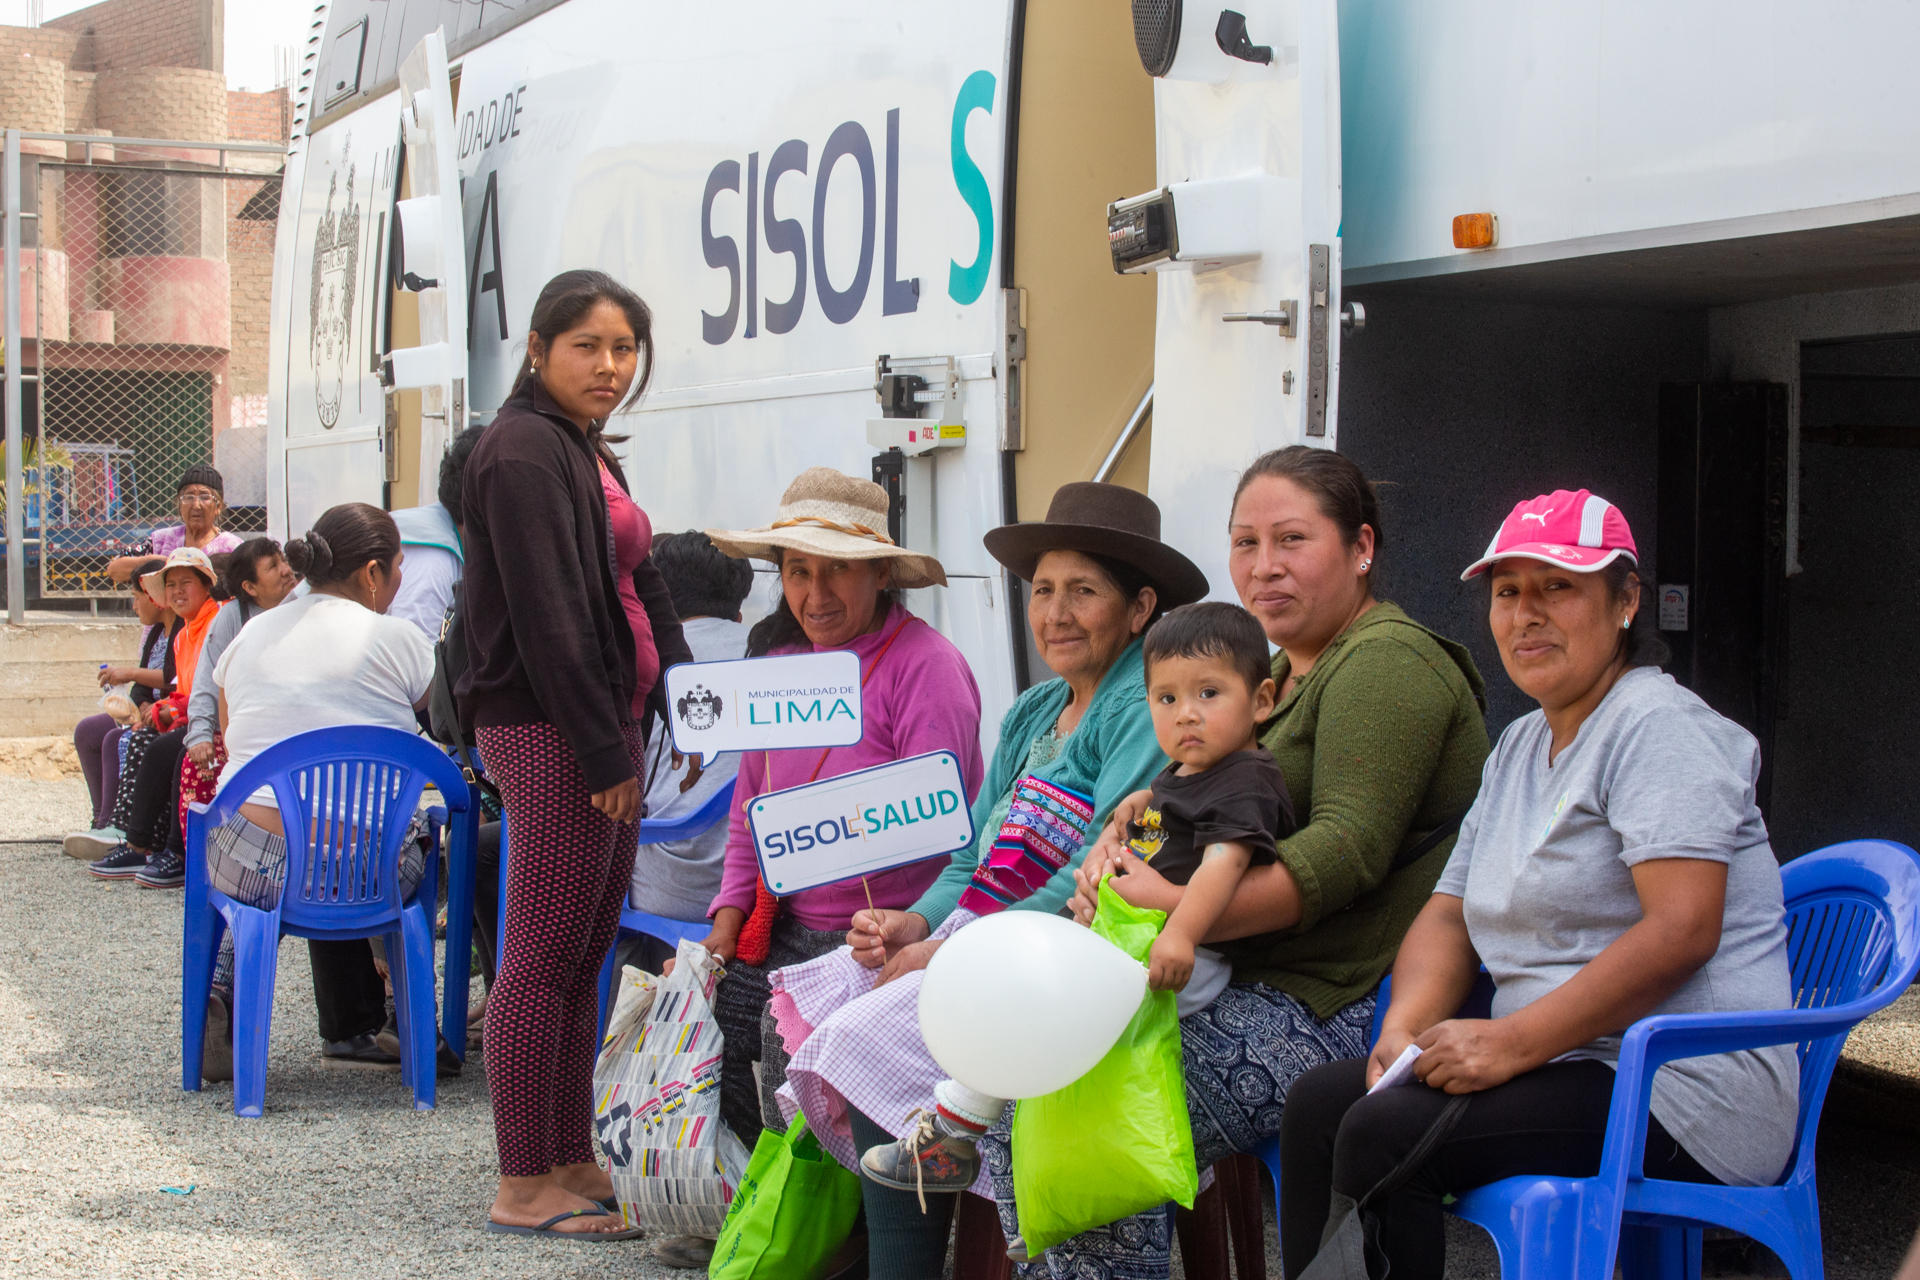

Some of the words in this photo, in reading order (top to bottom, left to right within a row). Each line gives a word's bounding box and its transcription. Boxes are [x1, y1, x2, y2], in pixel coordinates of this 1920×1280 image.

[498, 84, 527, 144] DE
[700, 106, 920, 346] SISOL
[948, 69, 997, 306] S
[922, 426, 935, 440] ADE
[748, 686, 837, 699] MUNICIPALIDAD
[839, 685, 855, 695] DE
[749, 698, 857, 725] LIMA
[763, 815, 860, 859] SISOL
[863, 789, 959, 834] SALUD
